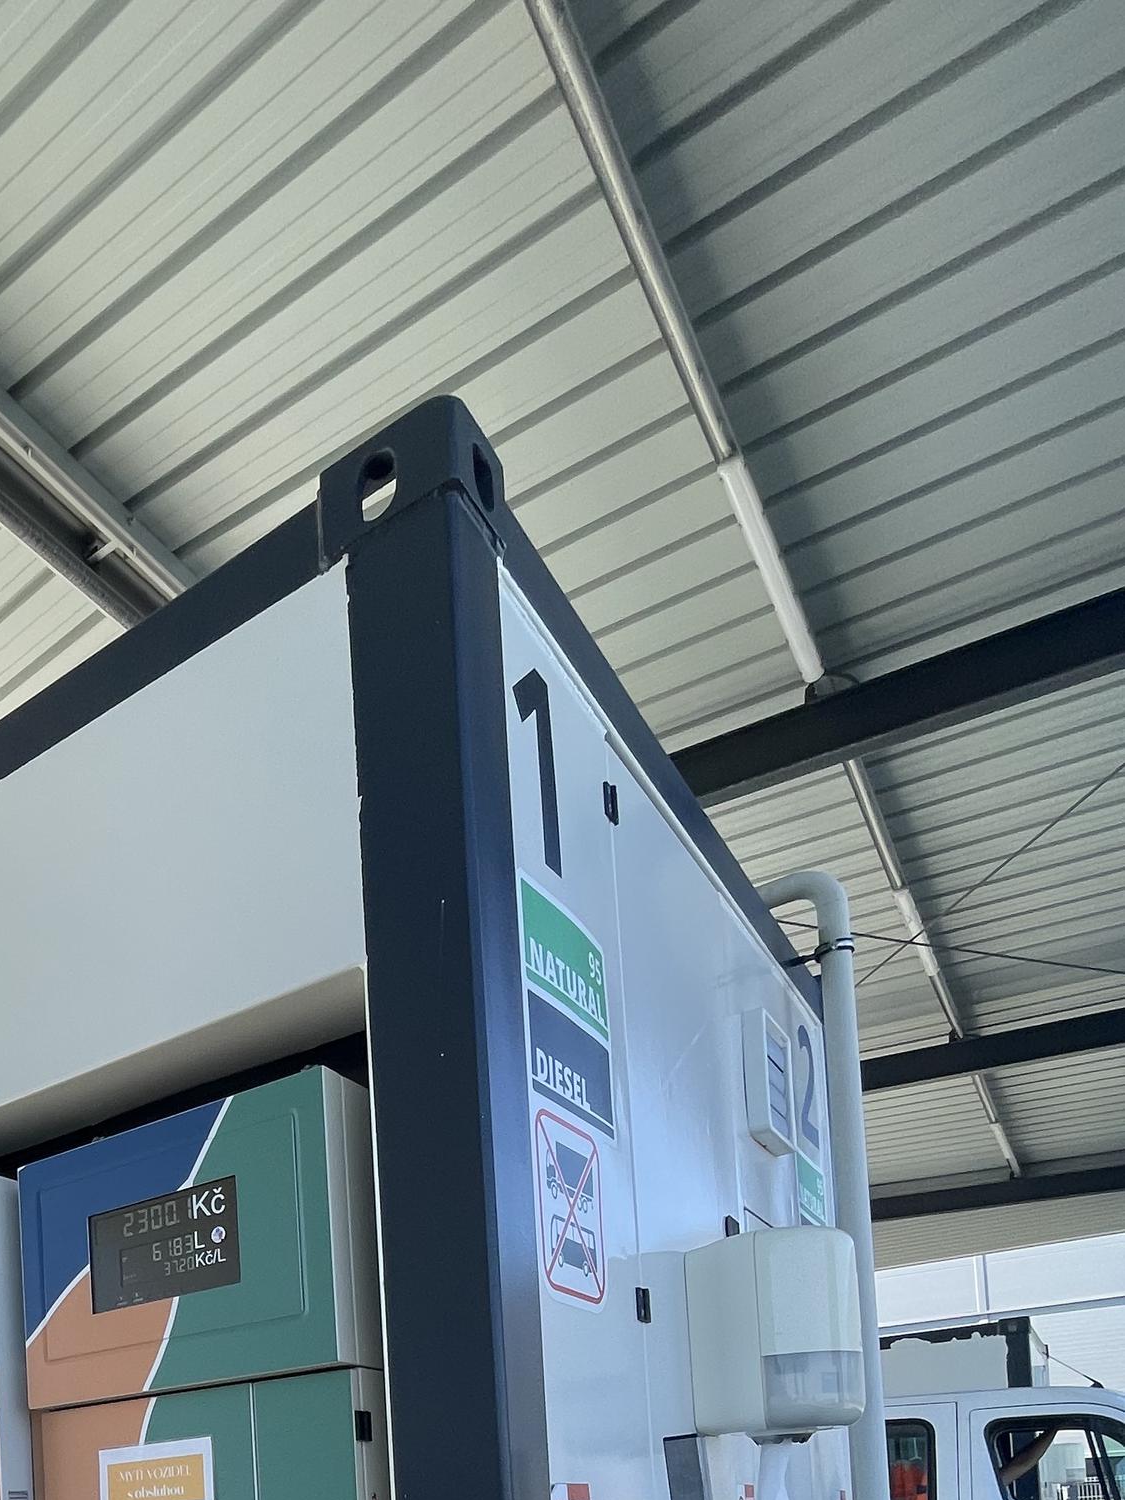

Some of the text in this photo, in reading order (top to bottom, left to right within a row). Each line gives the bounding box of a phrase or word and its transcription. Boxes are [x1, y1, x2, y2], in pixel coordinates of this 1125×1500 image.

[512, 668, 563, 878] 1
[529, 936, 606, 1026] NATURAL
[588, 951, 603, 986] 95
[536, 1047, 591, 1112] DIESEL
[798, 1025, 820, 1150] 2
[192, 1187, 226, 1219] Kč
[194, 1231, 206, 1249] L
[195, 1248, 227, 1268] Kč/L
